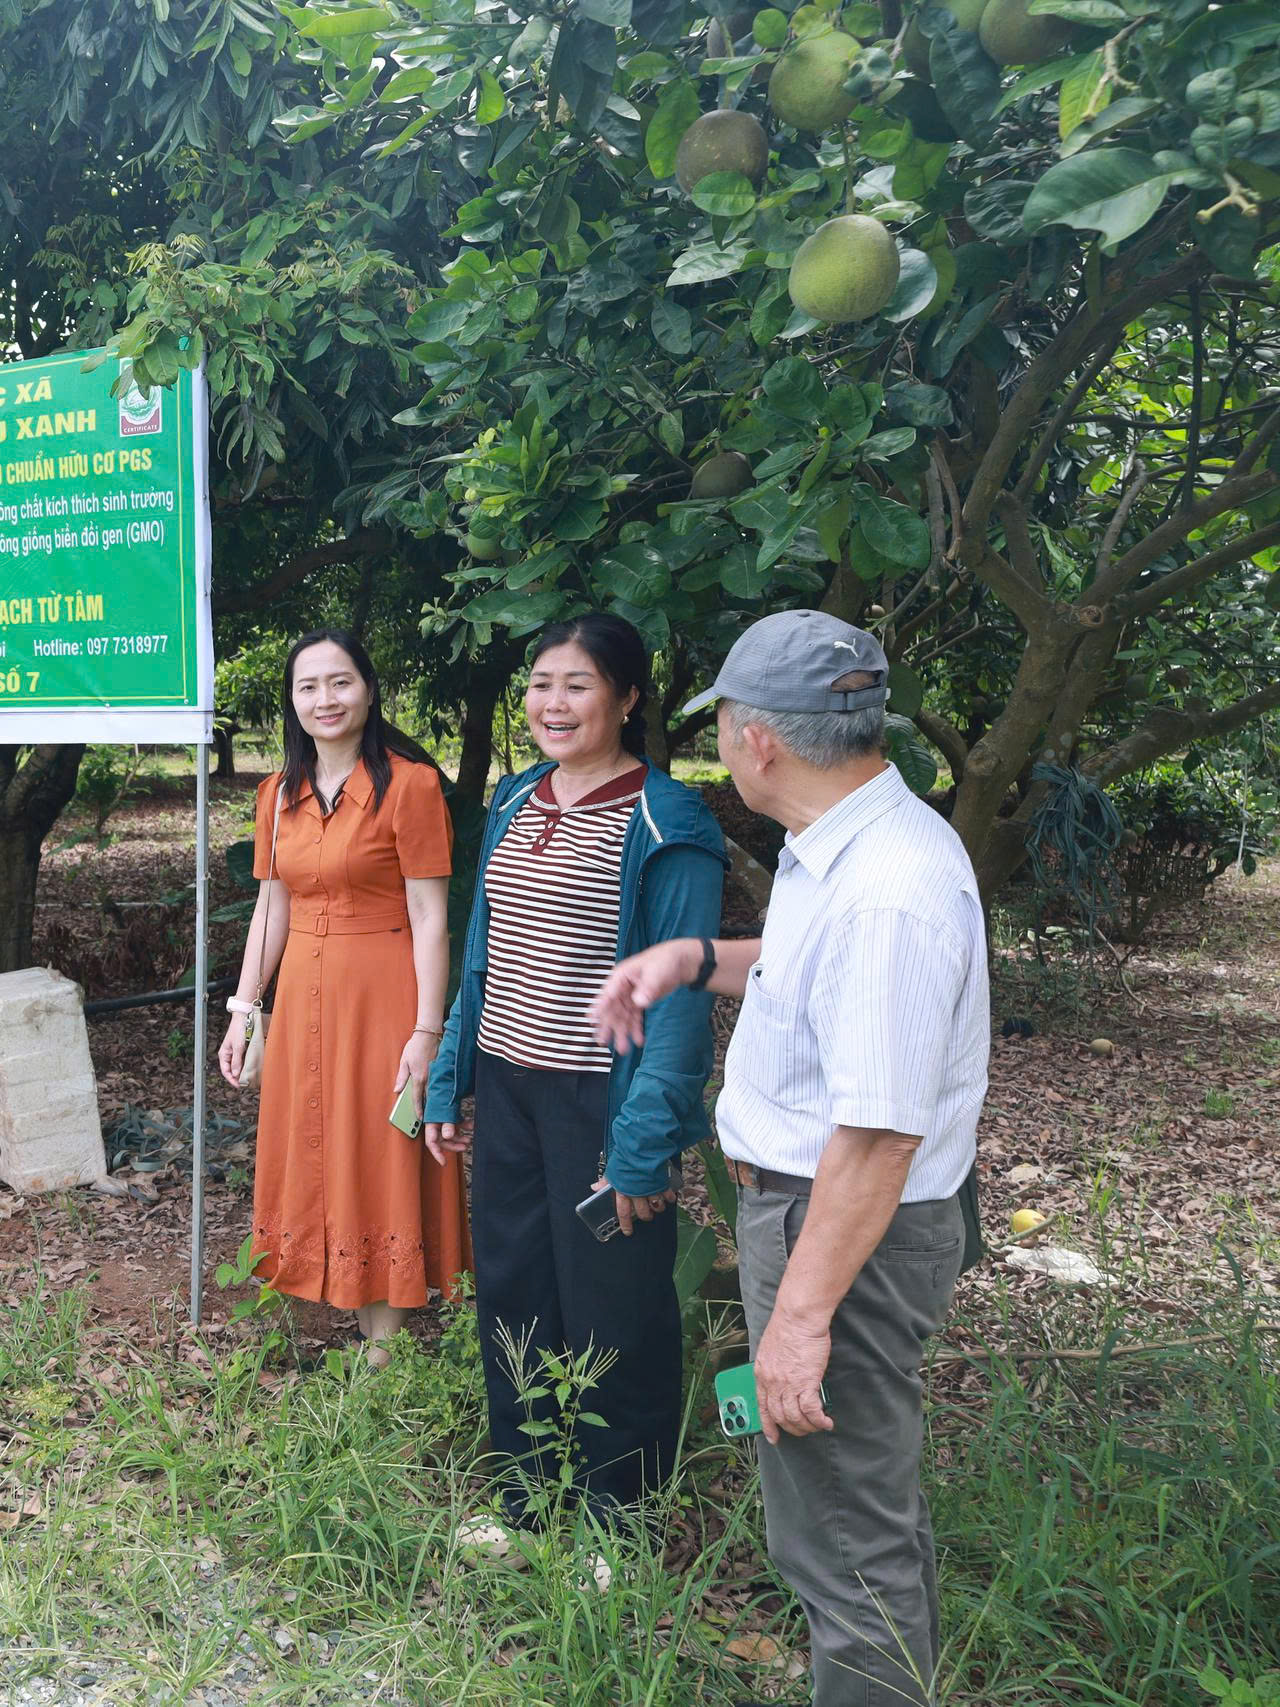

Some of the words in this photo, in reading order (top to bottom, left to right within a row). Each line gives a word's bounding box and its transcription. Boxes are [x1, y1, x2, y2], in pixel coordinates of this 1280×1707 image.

[14, 375, 53, 405] XÃ
[16, 409, 96, 440] XANH
[123, 425, 157, 433] CERTIFICATE
[6, 450, 54, 485] CHUẨN
[58, 450, 89, 479] HỮU
[92, 450, 115, 475] CƠ
[119, 448, 152, 473] PGS
[21, 493, 43, 519] chất
[46, 495, 69, 516] kích
[71, 491, 99, 515] thích
[102, 490, 127, 511] sinh
[130, 486, 174, 512] trưởng
[21, 526, 52, 556] giống
[81, 520, 99, 546] đổi
[102, 528, 123, 550] gen
[126, 520, 165, 548] (GMO)
[37, 590, 62, 623] TỪ
[65, 589, 104, 622] TÂM
[33, 638, 83, 657] Hotline:
[87, 637, 109, 655] 097
[112, 635, 168, 654] 7318977
[26, 672, 40, 693] 7
